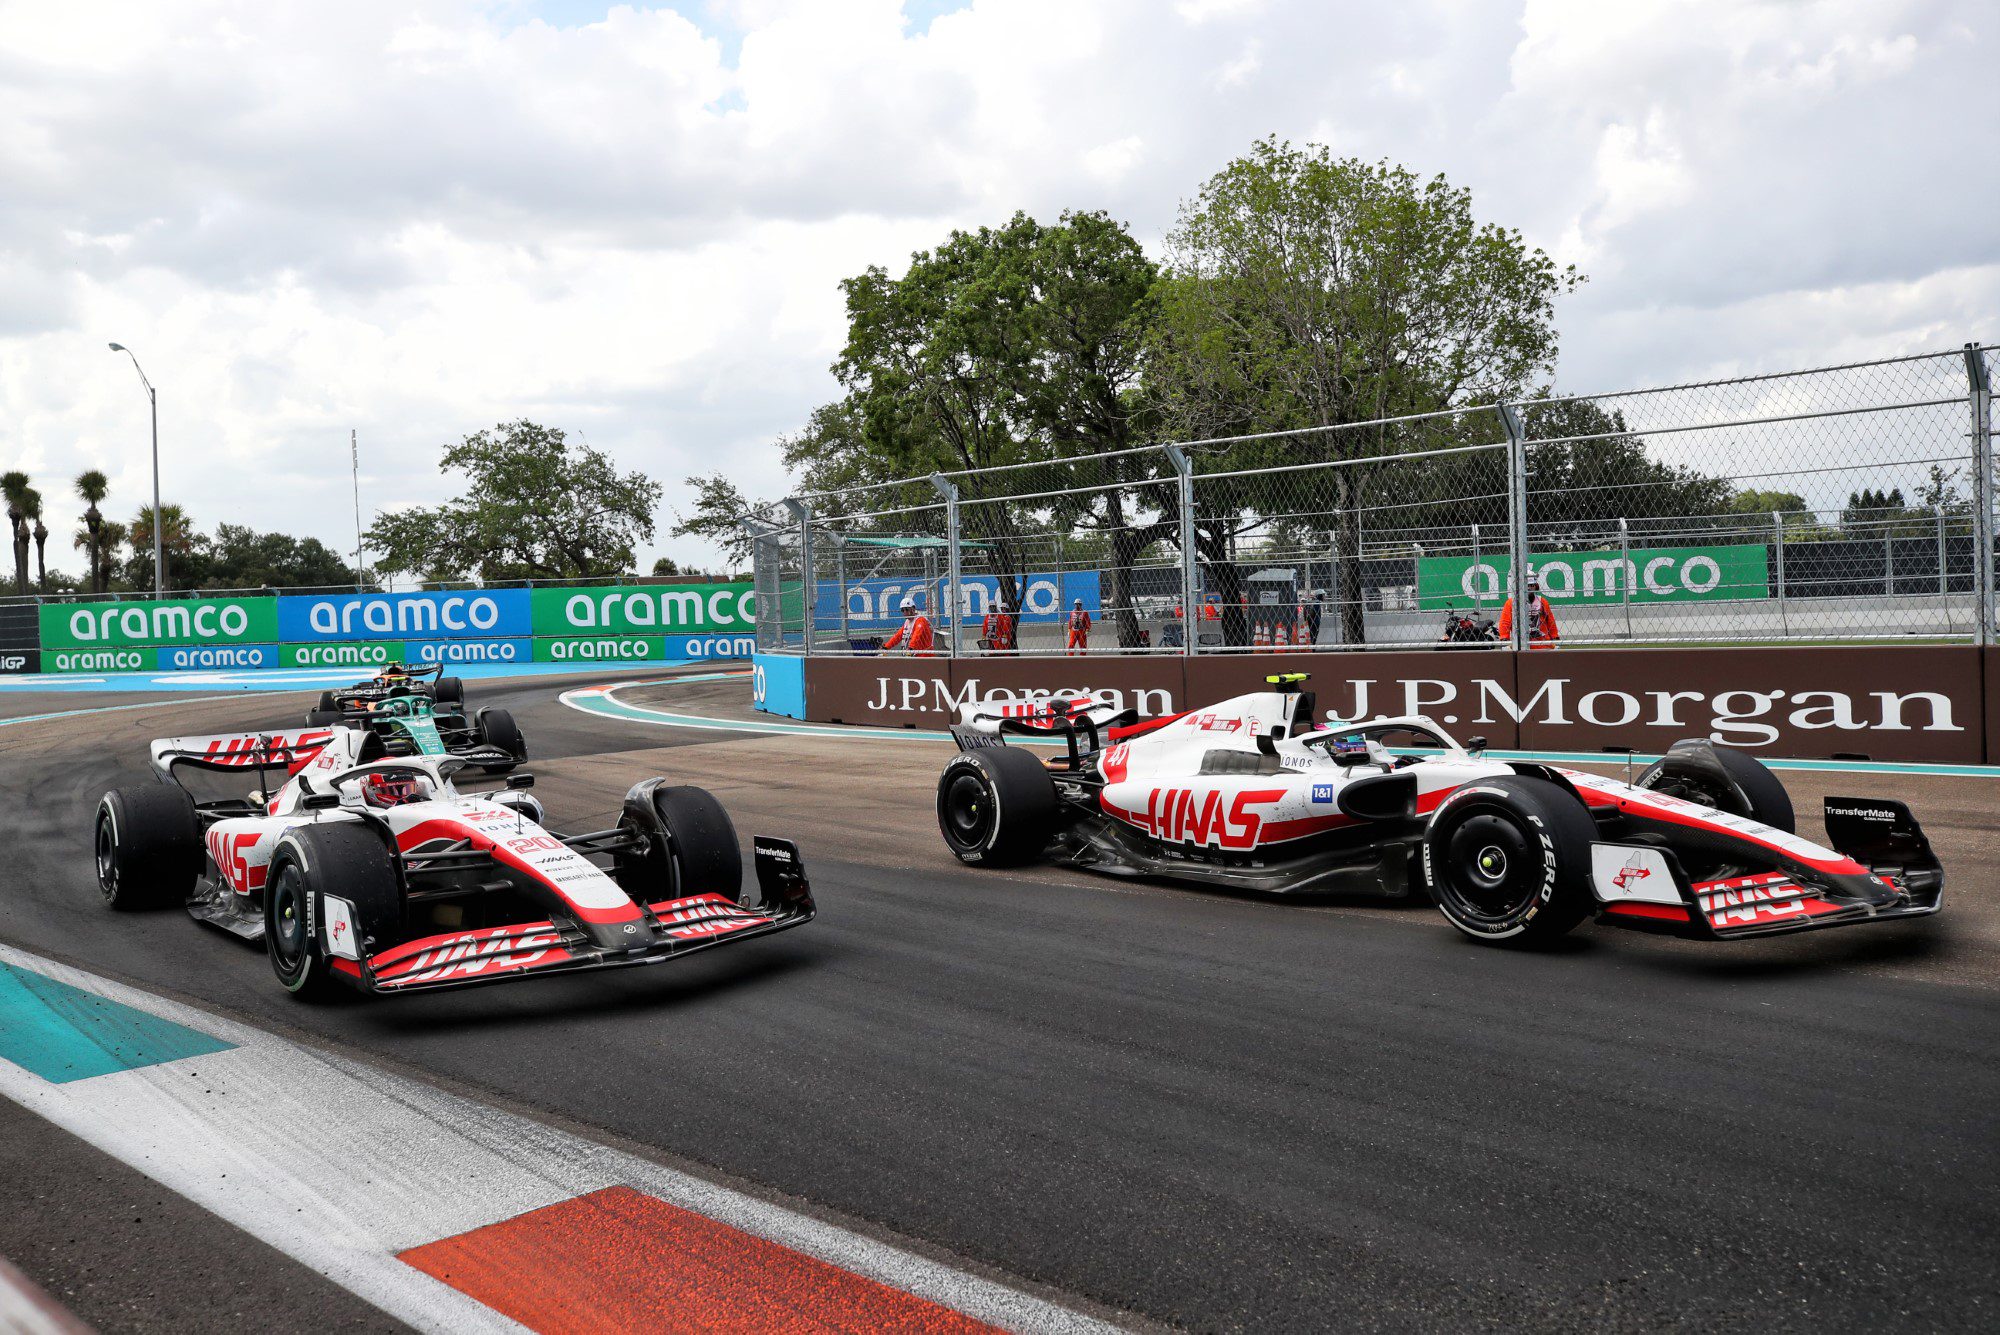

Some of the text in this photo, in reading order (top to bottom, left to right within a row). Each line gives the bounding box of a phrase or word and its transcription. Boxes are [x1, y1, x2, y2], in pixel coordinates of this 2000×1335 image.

[309, 597, 498, 634] aramco
[565, 590, 768, 627] aramco
[69, 604, 248, 640] aramco
[173, 649, 263, 667] aramco
[295, 646, 387, 664] aramco
[420, 643, 516, 661] aramco
[551, 640, 649, 658] aramco
[56, 652, 142, 670] aramco
[868, 677, 1174, 716] J.P.Man
[1325, 679, 1965, 746] J.P.Morgan
[957, 734, 997, 750] IONOS
[1280, 756, 1313, 768] IONOS
[1313, 788, 1332, 799] 1&1
[1130, 788, 1289, 849] HAAS
[1824, 806, 1896, 818] TransferMate
[506, 836, 564, 854] 20
[755, 846, 791, 859] TransferMate
[1526, 814, 1557, 903] P ZERO
